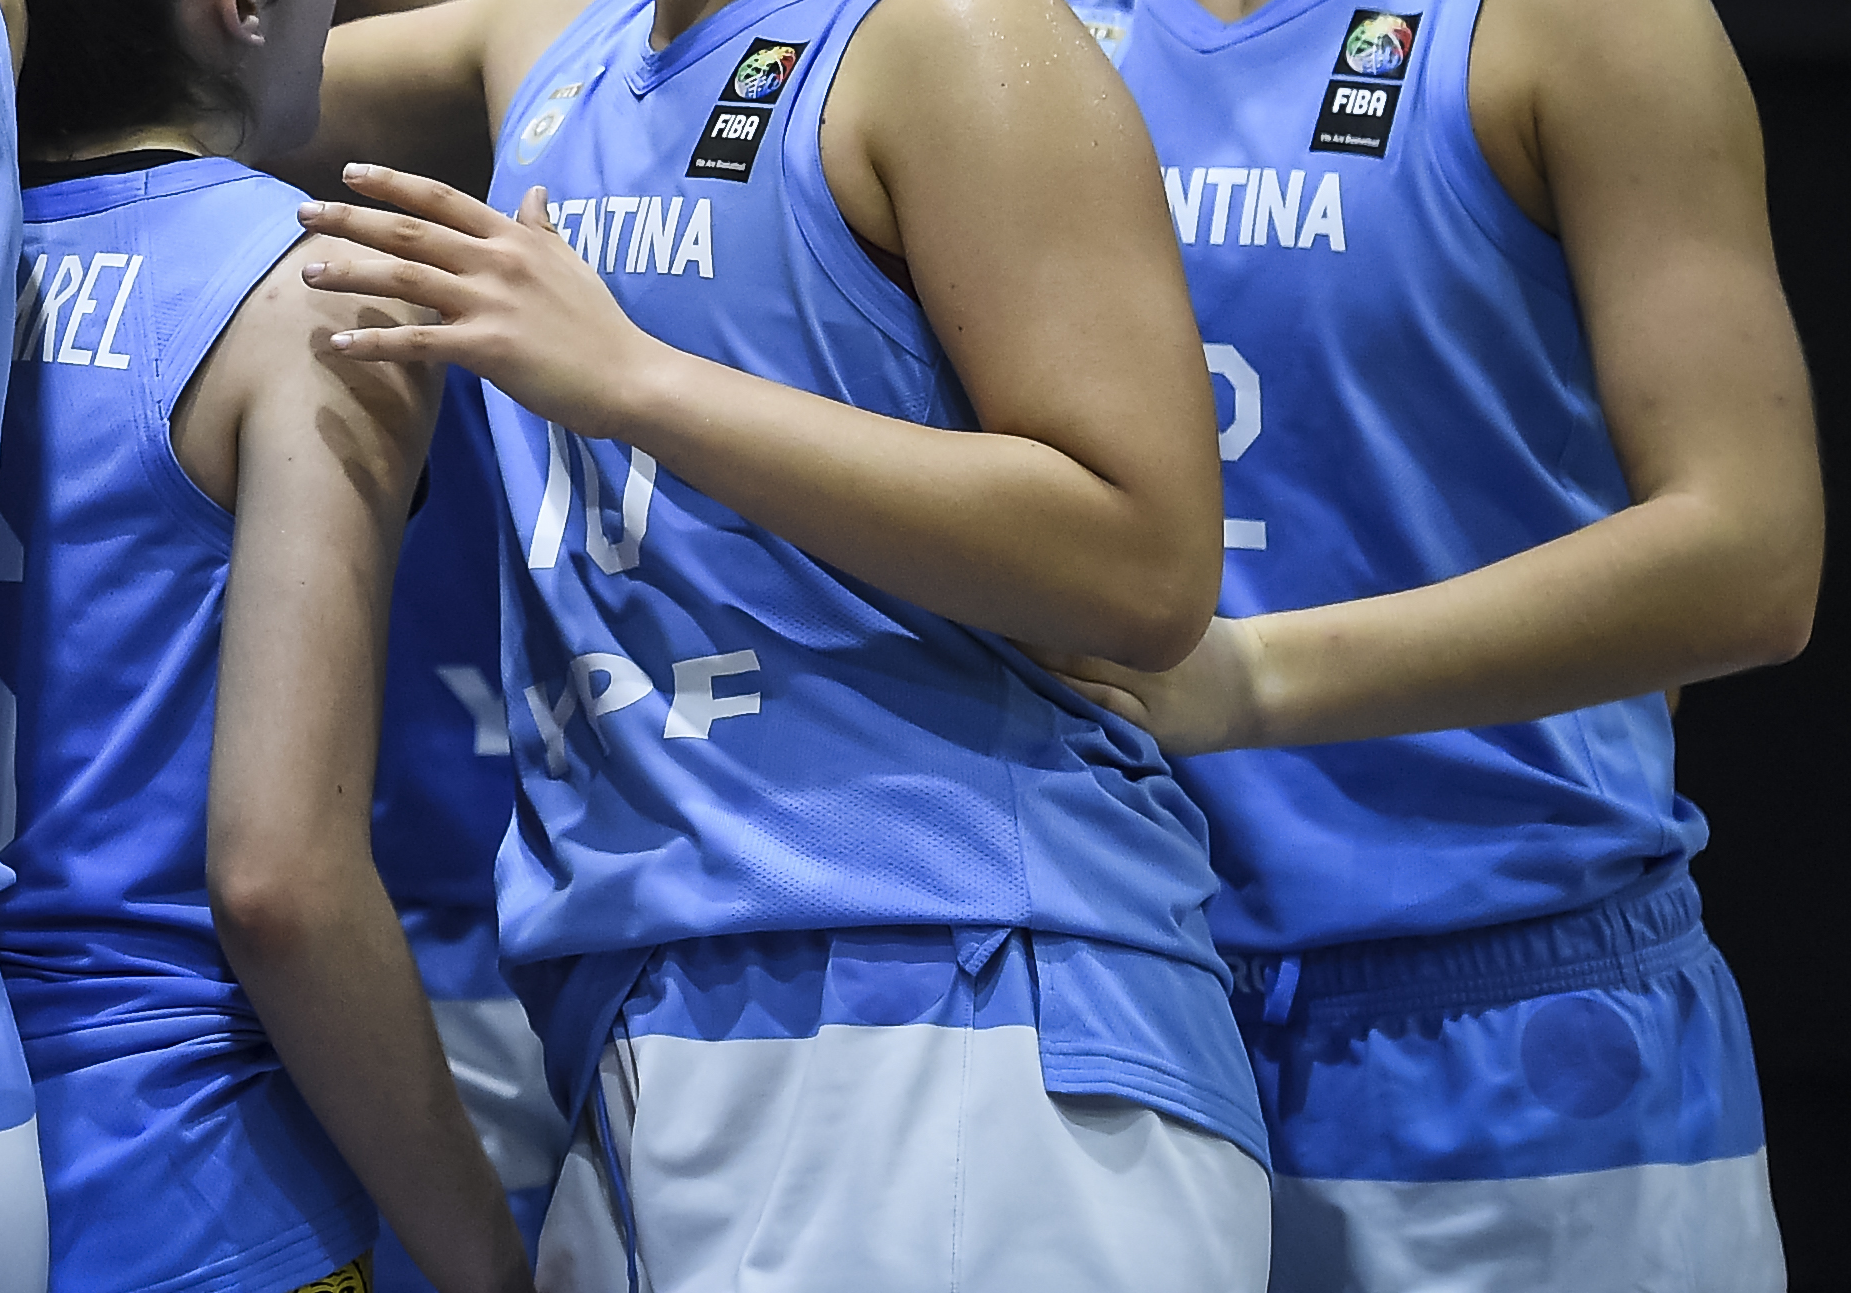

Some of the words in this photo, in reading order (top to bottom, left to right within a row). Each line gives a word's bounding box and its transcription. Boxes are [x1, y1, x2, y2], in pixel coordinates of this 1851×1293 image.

[1332, 88, 1386, 118] FIBA
[711, 114, 760, 141] FIBA
[524, 650, 761, 779] YPF
